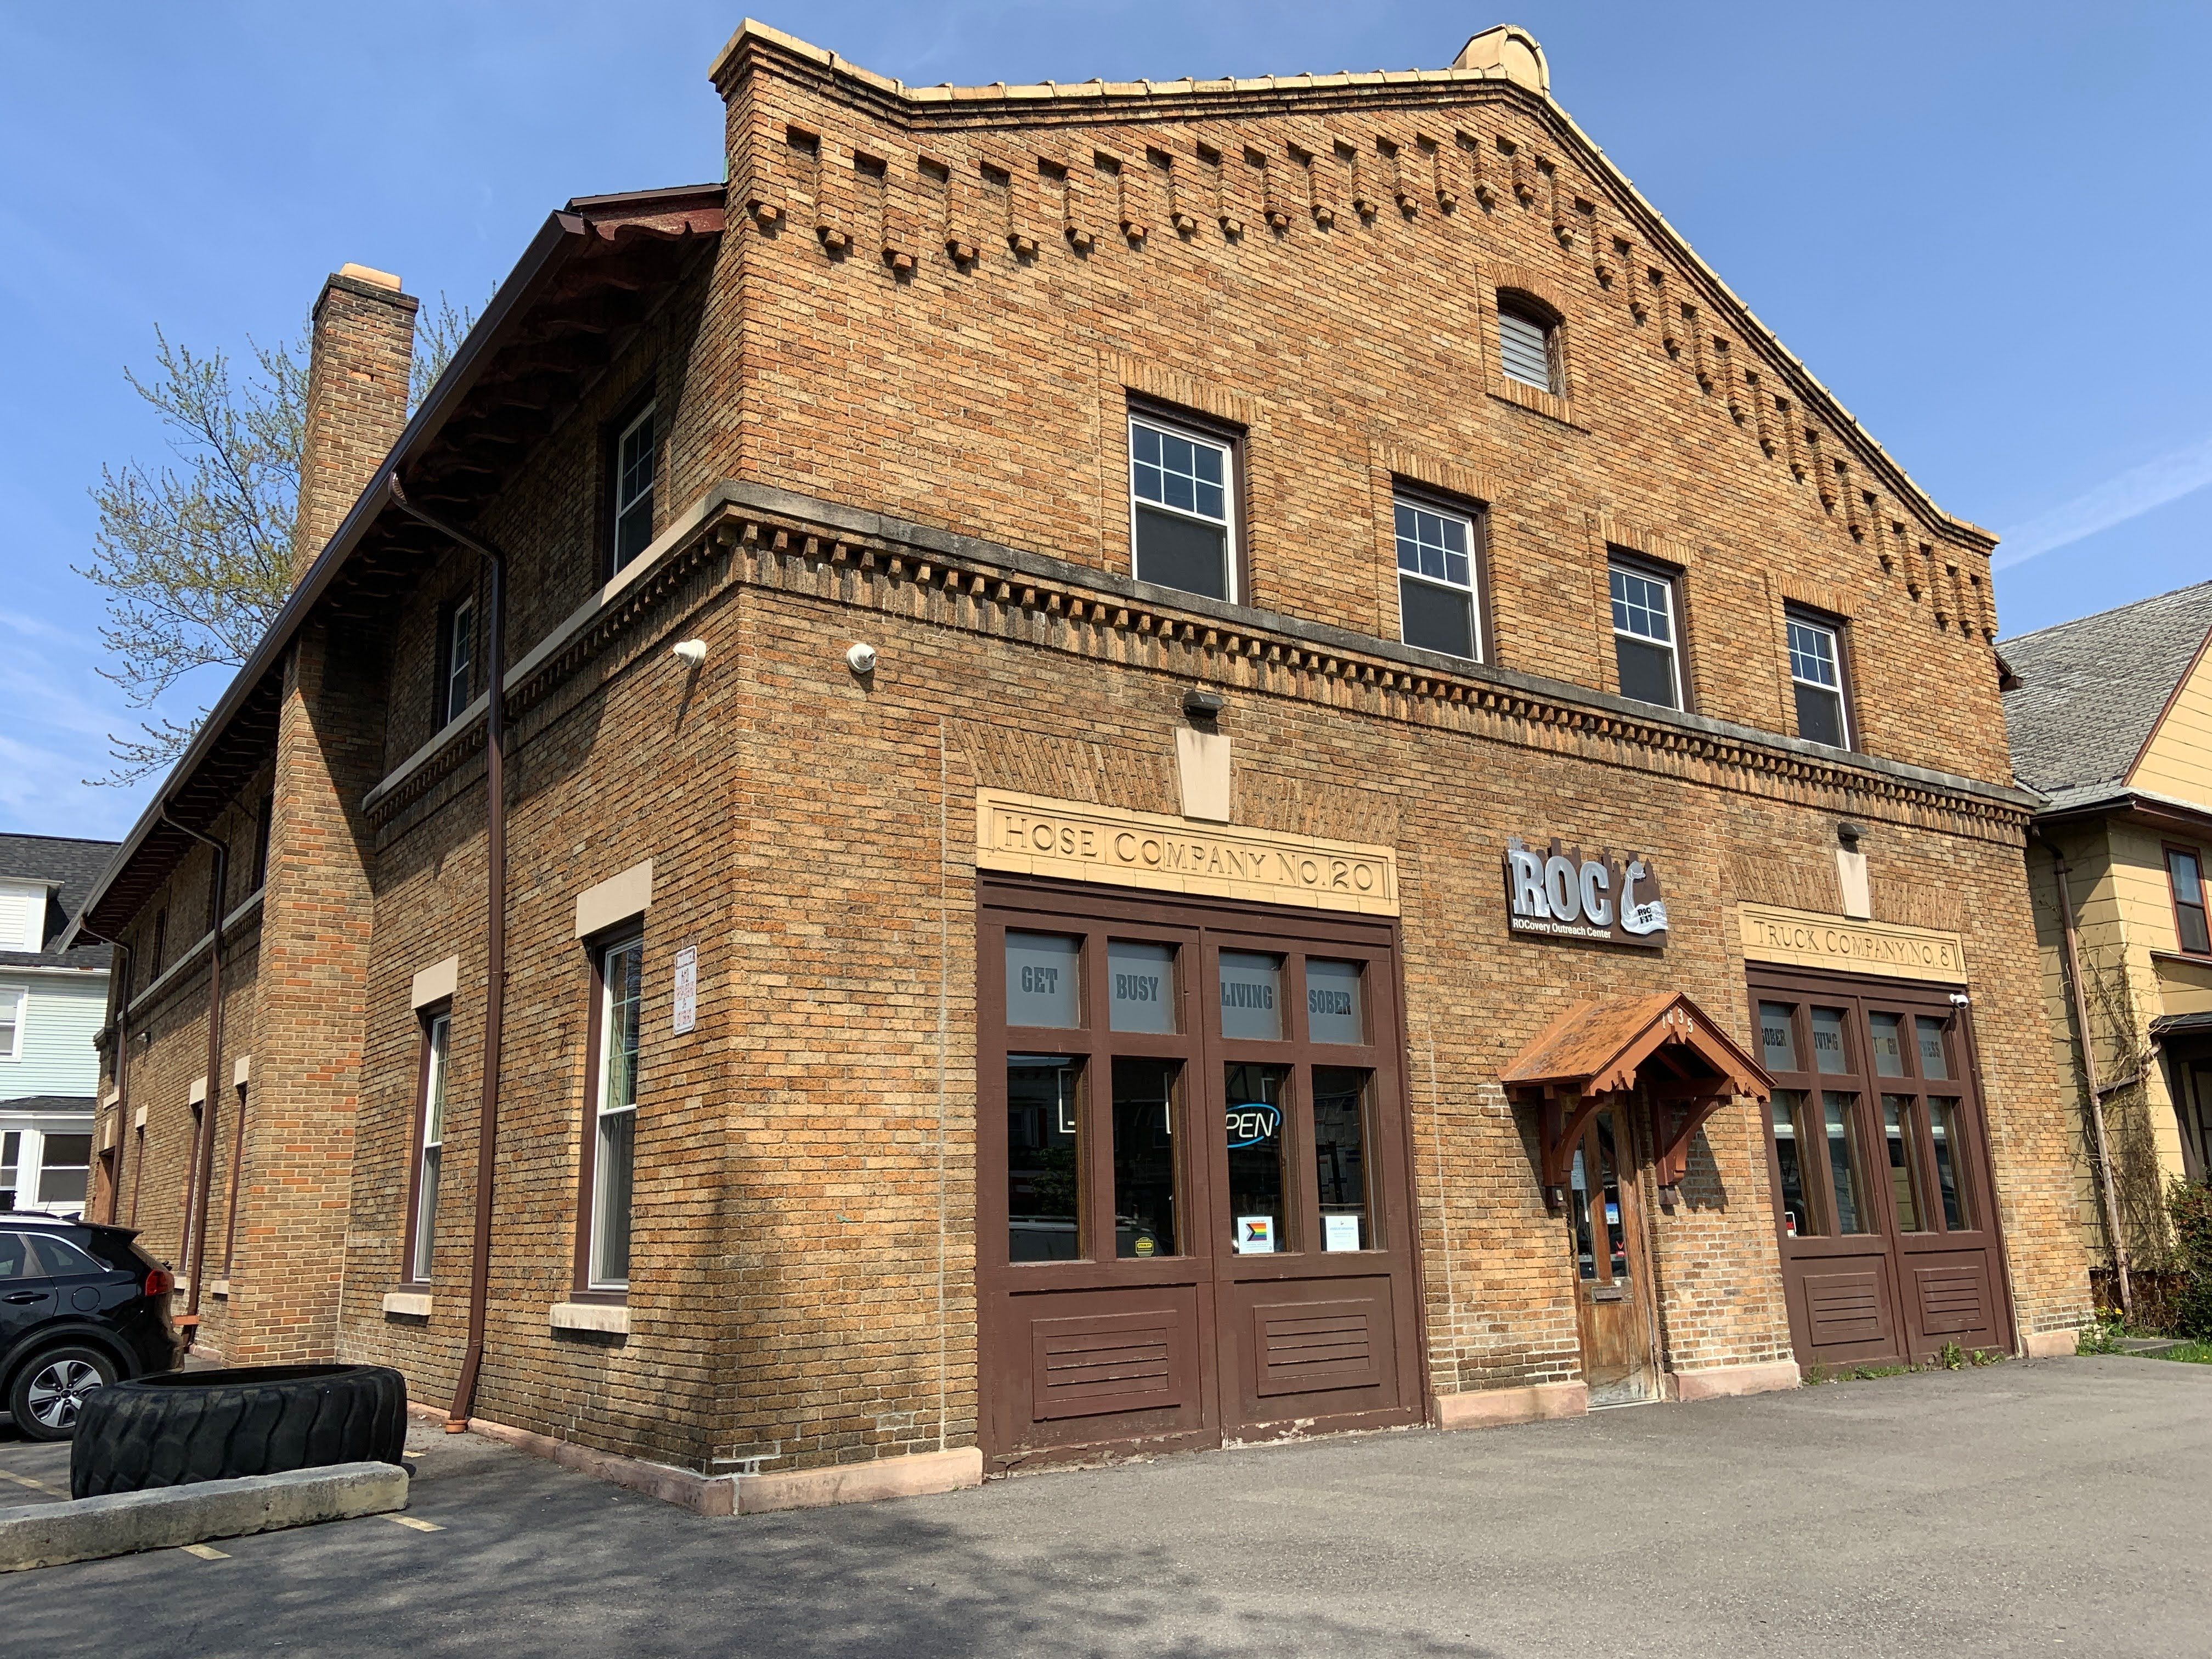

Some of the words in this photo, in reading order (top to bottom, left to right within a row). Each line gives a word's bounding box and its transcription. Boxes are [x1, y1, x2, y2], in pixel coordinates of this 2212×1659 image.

[1005, 815, 1098, 857] HOSE
[1114, 832, 1266, 879] COMPANY
[1509, 849, 1613, 926] ROC
[1637, 907, 1651, 916] ROC
[1640, 914, 1652, 924] FIT
[1513, 918, 1550, 933] ROCovery
[1551, 923, 1586, 935] Outreach
[1587, 927, 1611, 939] Center
[1754, 921, 1819, 950] TRUCK
[1826, 930, 1906, 961] COMPANY
[1022, 966, 1058, 994] GET
[1116, 974, 1159, 1001] BUSY
[1221, 982, 1273, 1009] LIVING
[1309, 990, 1351, 1015] SOBER
[1814, 1032, 1839, 1050] IVING
[1871, 1037, 1898, 1054] TGH
[1226, 1113, 1274, 1138] PEN
